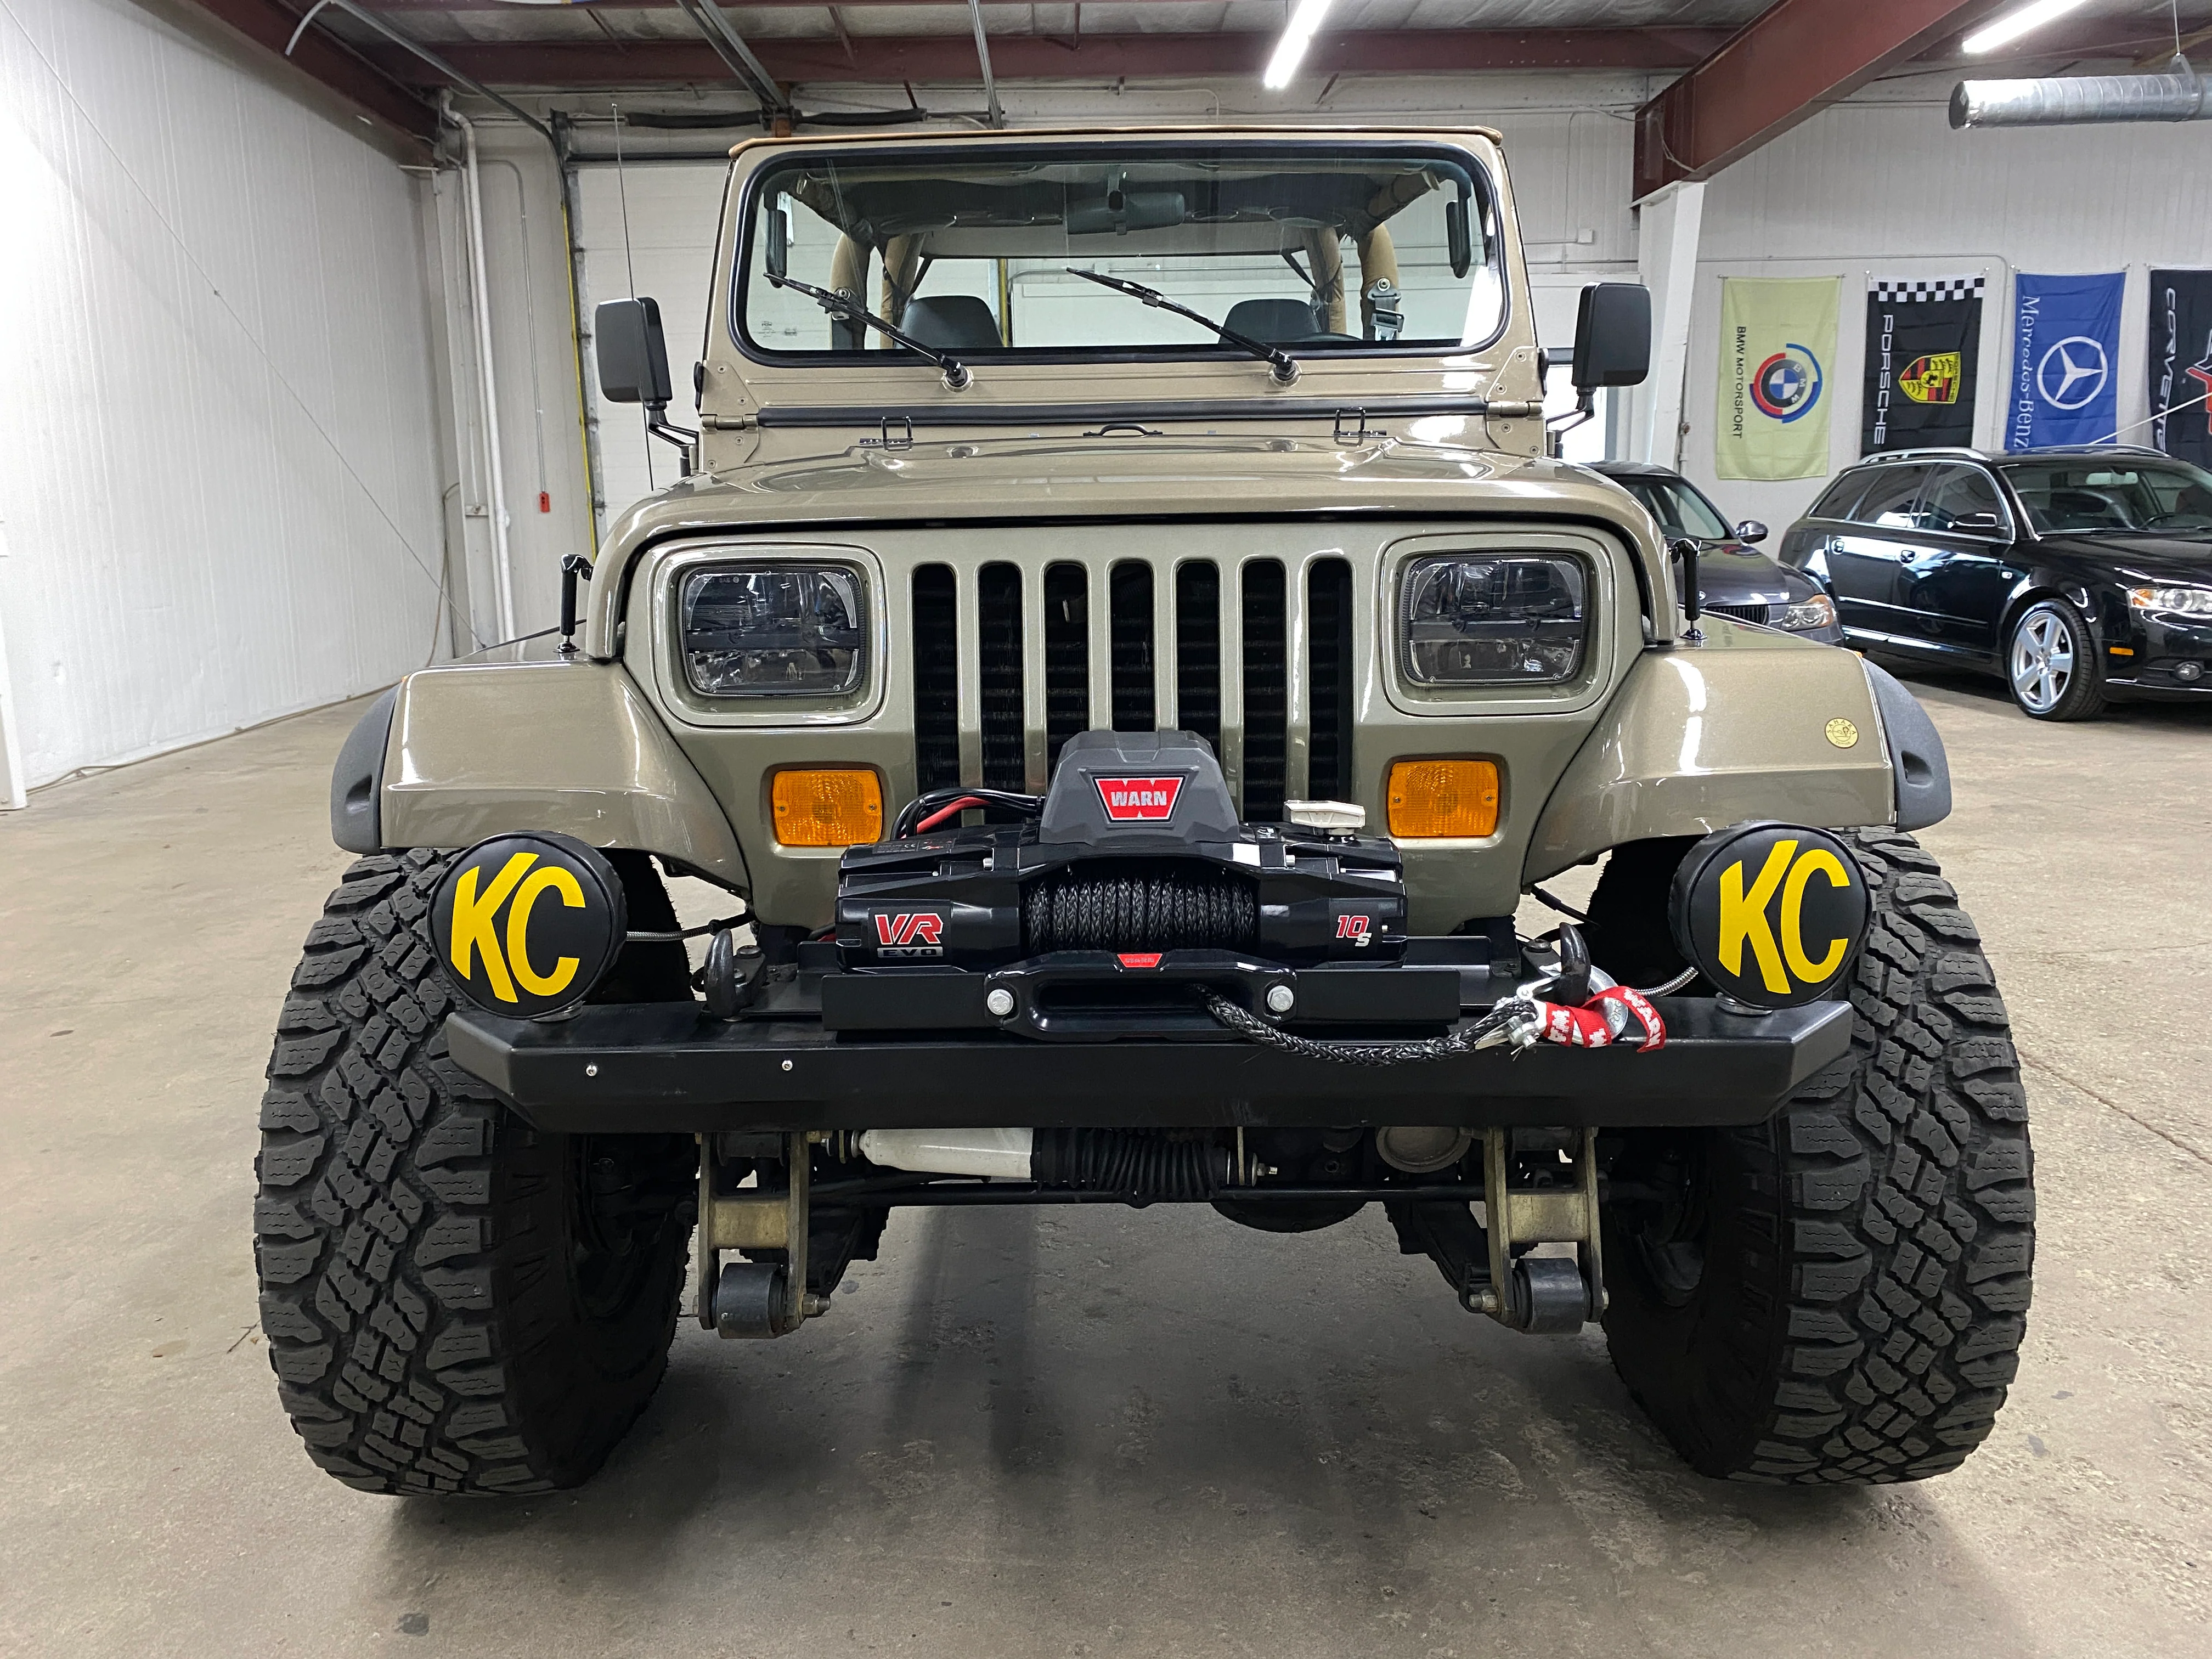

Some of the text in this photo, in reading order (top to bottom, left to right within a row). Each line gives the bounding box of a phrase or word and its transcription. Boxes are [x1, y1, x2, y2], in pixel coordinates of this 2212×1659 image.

[1733, 326, 1746, 438] BMW MOTORSPORT
[1791, 363, 1806, 403] BMW
[1874, 314, 1894, 444] PORSCHE
[2013, 296, 2041, 448] Mercedes-Benz
[2157, 287, 2176, 452] CORVETTE
[1110, 791, 1167, 807] WARN
[450, 852, 586, 1003] KC
[874, 913, 944, 945] VR
[882, 949, 937, 957] EVO
[1335, 915, 1370, 938] 10
[1718, 839, 1850, 994] KC
